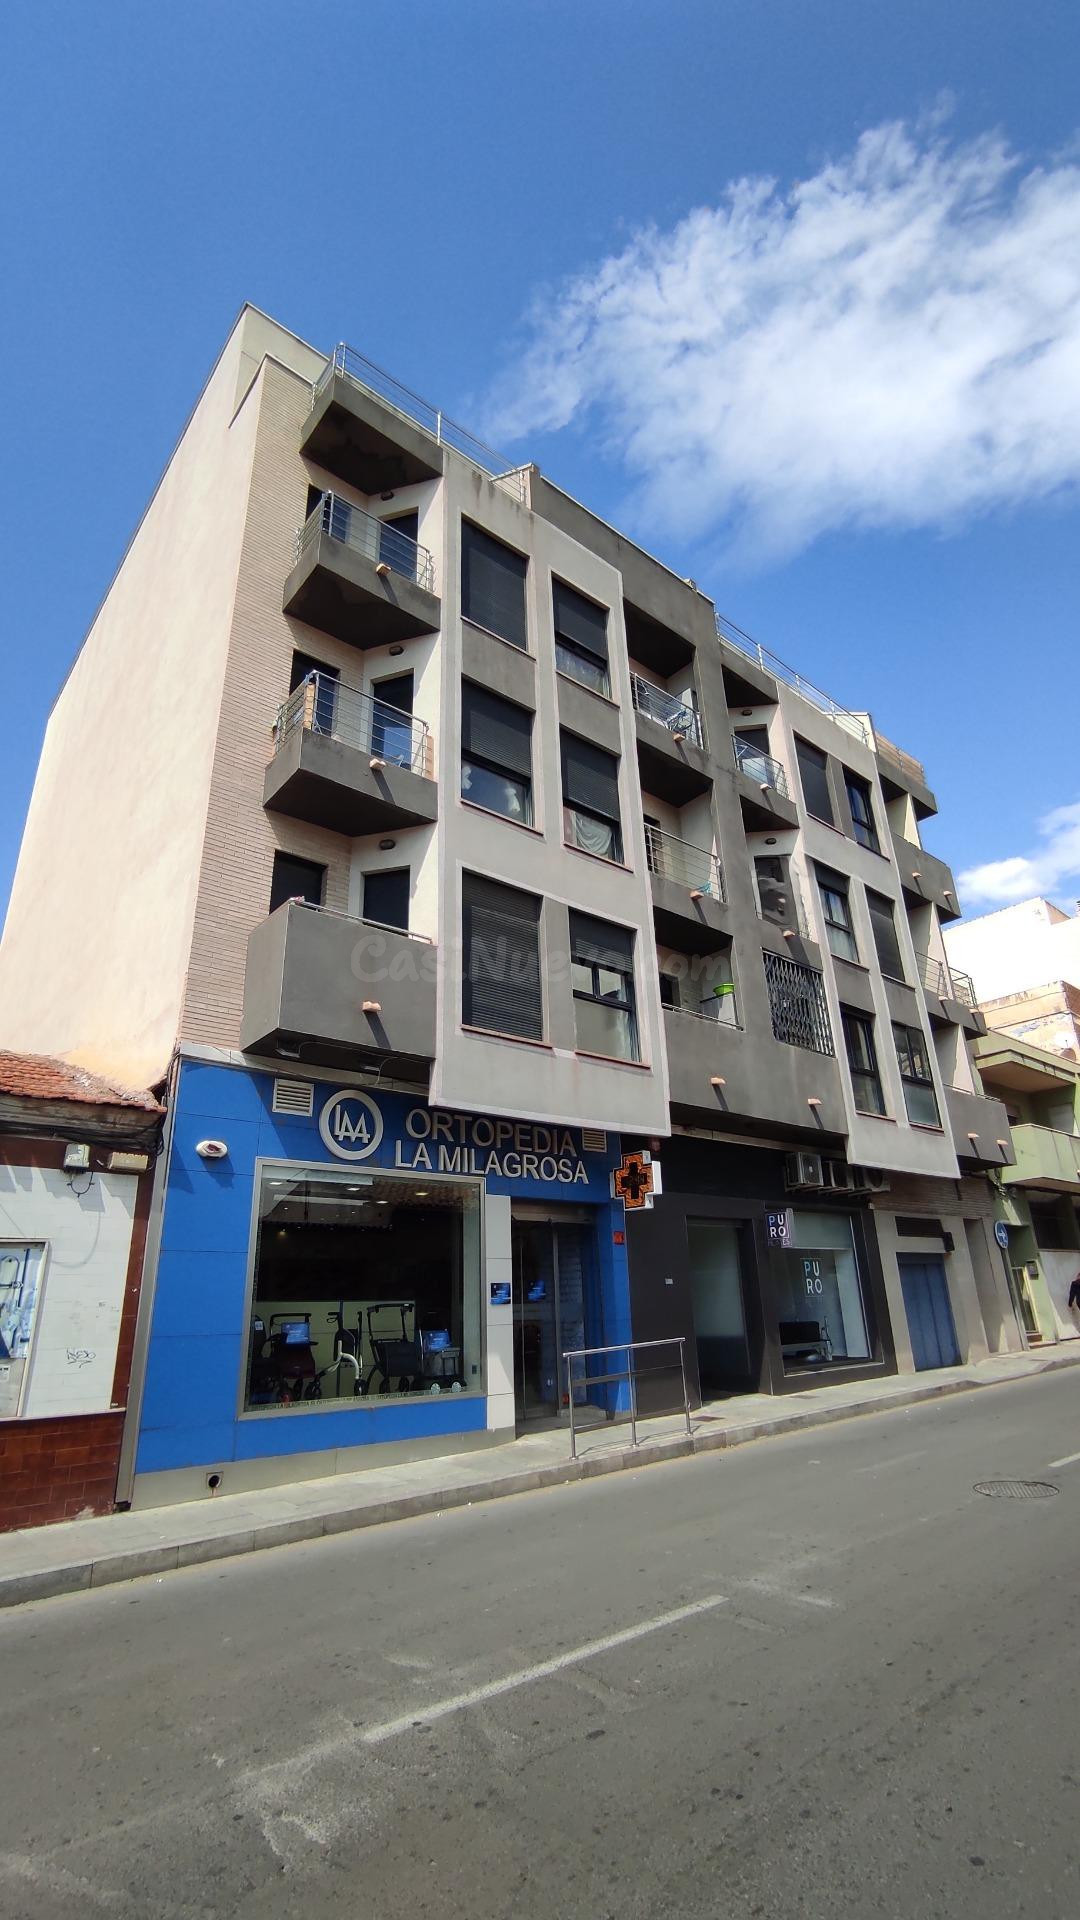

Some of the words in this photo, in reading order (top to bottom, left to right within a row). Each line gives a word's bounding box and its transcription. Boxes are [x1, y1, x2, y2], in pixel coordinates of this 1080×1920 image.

[405, 1108, 578, 1158] ORTOPEDIA
[395, 1140, 432, 1169] LA
[438, 1144, 589, 1184] MILAGROSA
